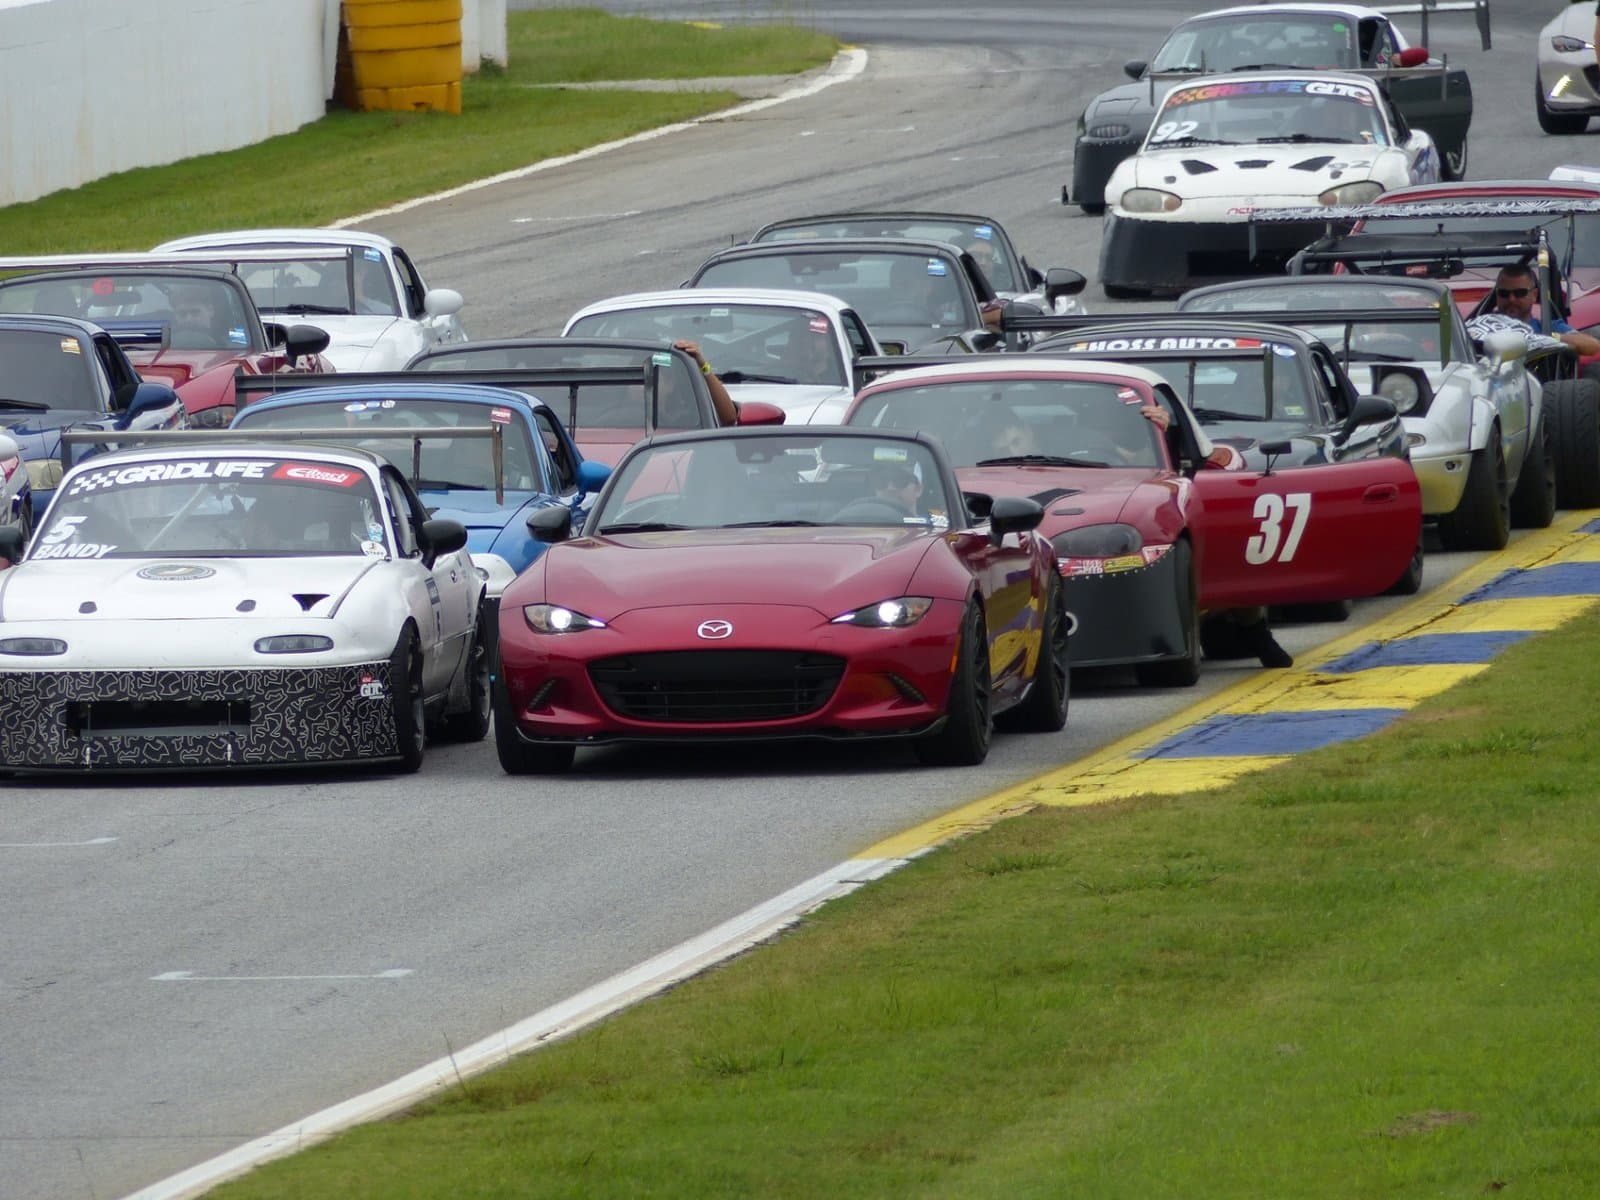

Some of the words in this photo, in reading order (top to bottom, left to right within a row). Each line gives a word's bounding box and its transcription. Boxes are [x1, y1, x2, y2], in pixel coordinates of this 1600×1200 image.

[1150, 120, 1199, 143] 92
[1159, 338, 1237, 350] AUTO
[115, 462, 276, 485] GRIDLIFE
[41, 515, 88, 544] 5
[1245, 492, 1312, 565] 37
[31, 543, 118, 560] BANDY
